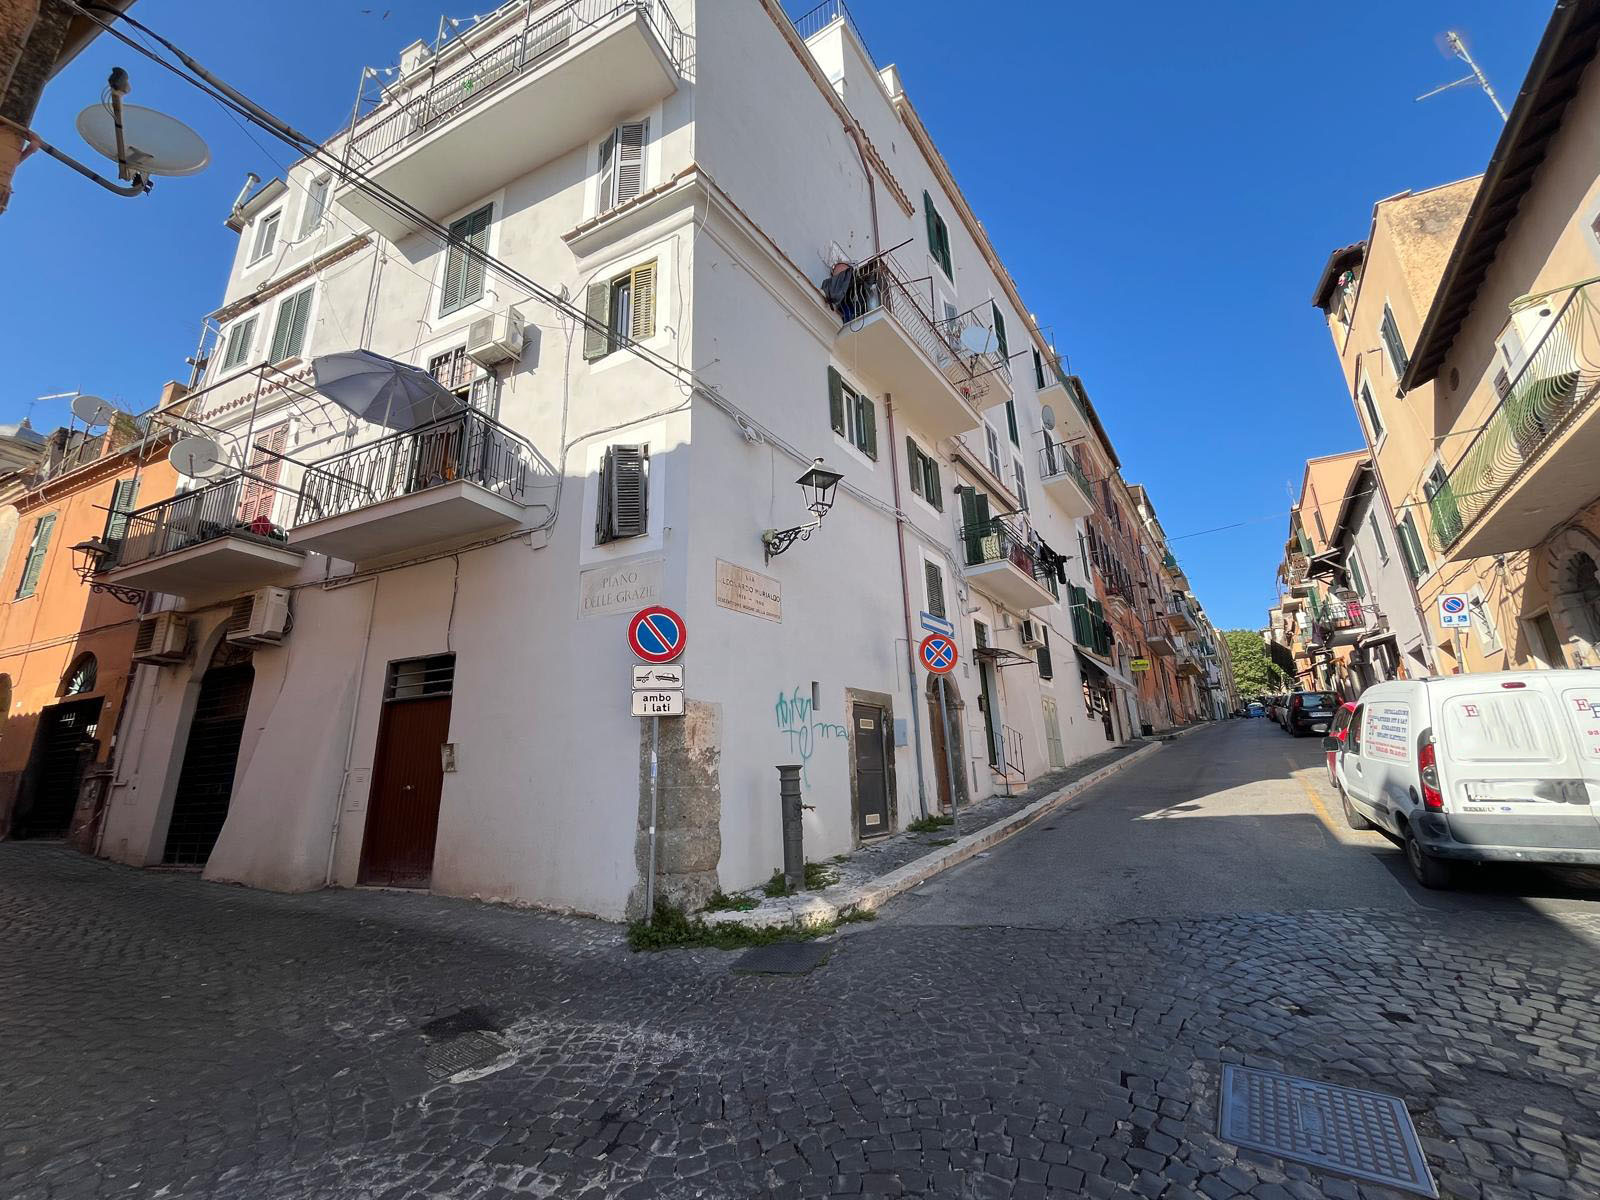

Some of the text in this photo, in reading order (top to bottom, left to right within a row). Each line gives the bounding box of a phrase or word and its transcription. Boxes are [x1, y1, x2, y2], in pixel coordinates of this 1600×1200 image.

[602, 572, 638, 589] PIANO
[584, 584, 656, 609] DELLE GRAZIE
[642, 693, 671, 702] ambo
[643, 703, 671, 712] i lati
[1462, 704, 1480, 717] E
